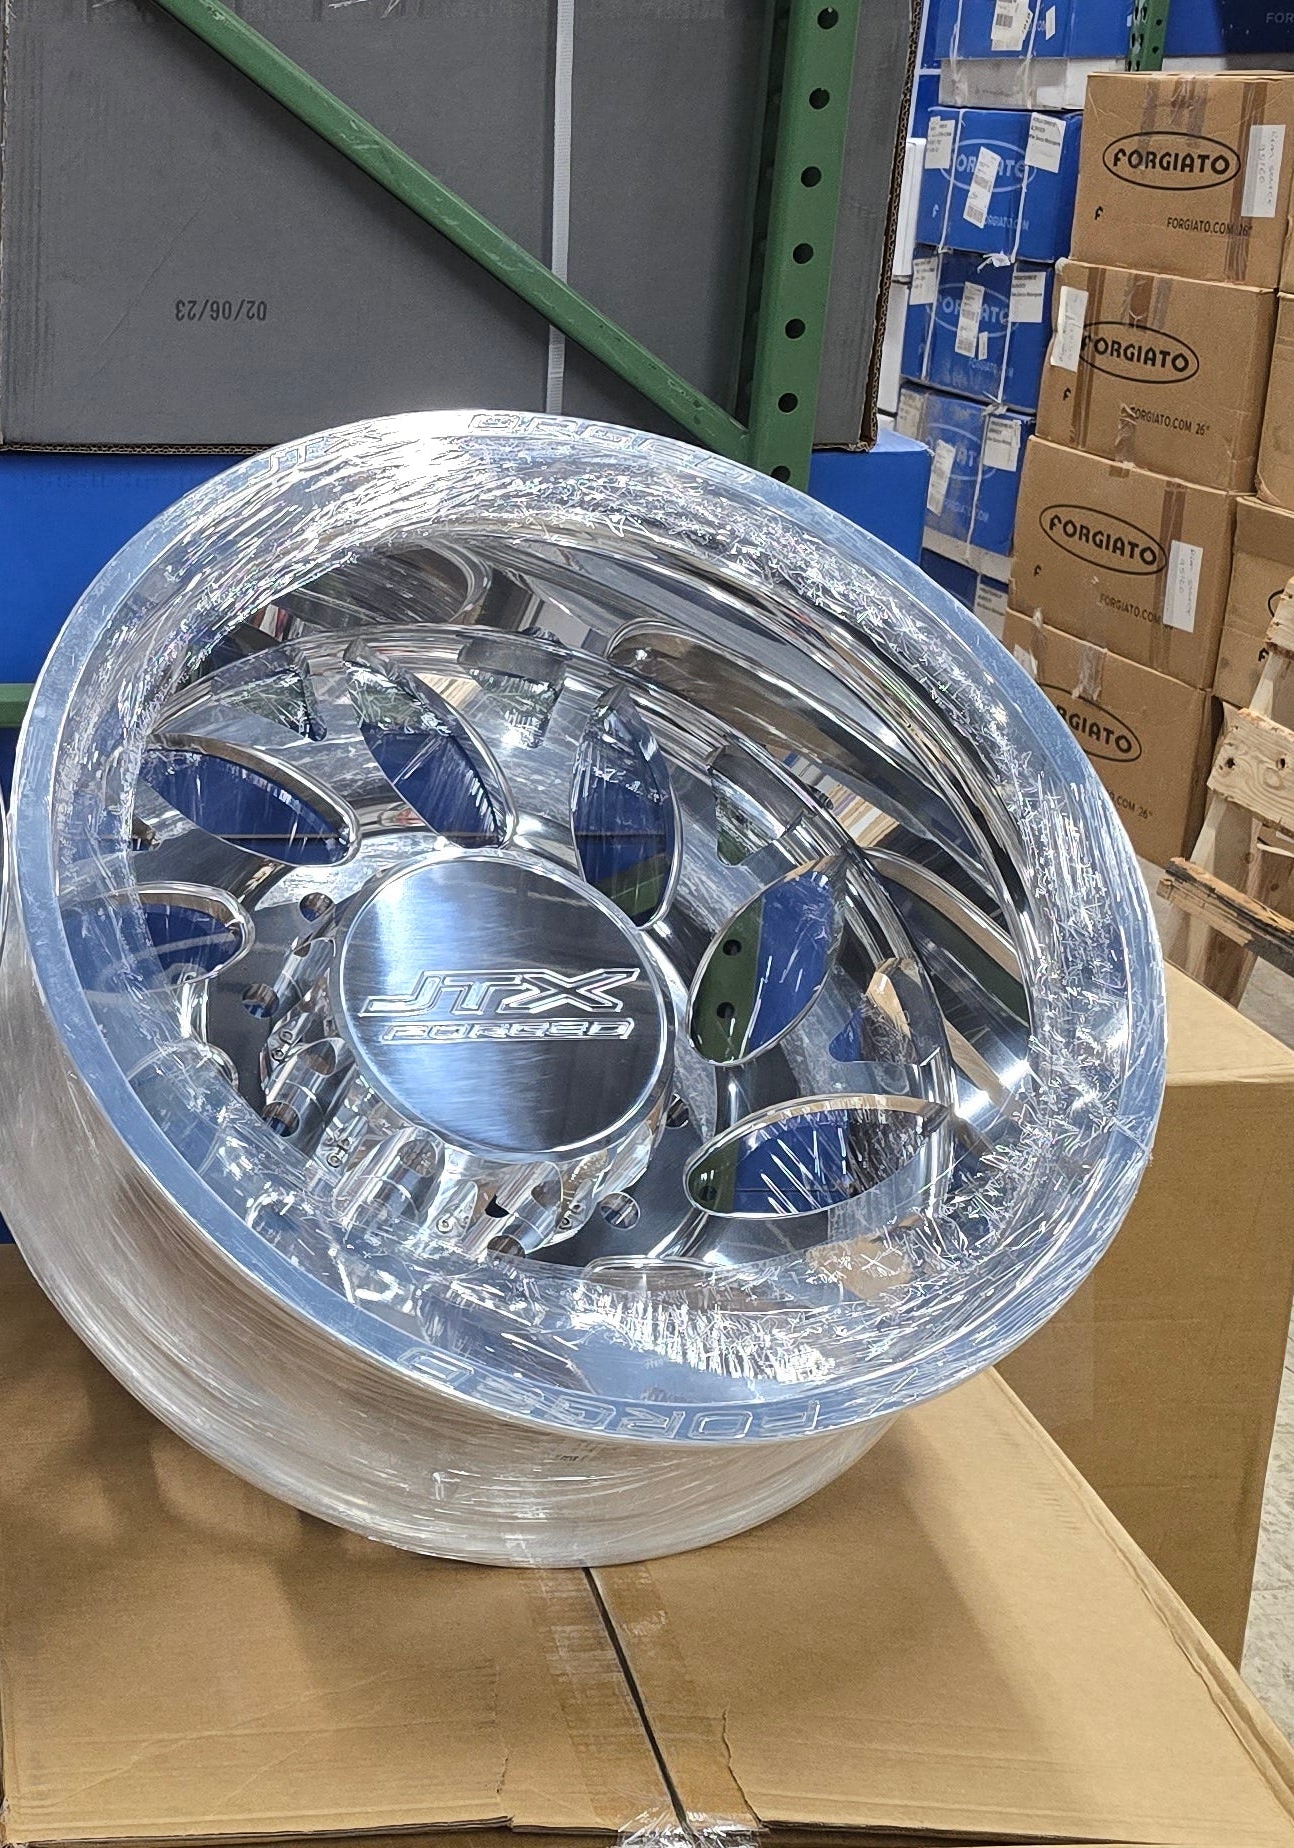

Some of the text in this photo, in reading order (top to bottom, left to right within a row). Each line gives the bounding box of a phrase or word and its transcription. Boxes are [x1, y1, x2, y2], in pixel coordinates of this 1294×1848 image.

[1113, 148, 1230, 175] FORGIATO
[1167, 217, 1235, 235] FORGIATO.COM
[175, 299, 267, 321] 02/06/23
[1080, 334, 1190, 373] FORGIATO
[1049, 514, 1157, 566] FORGIATO
[358, 967, 641, 1018] JTX
[381, 1017, 636, 1045] FORGED
